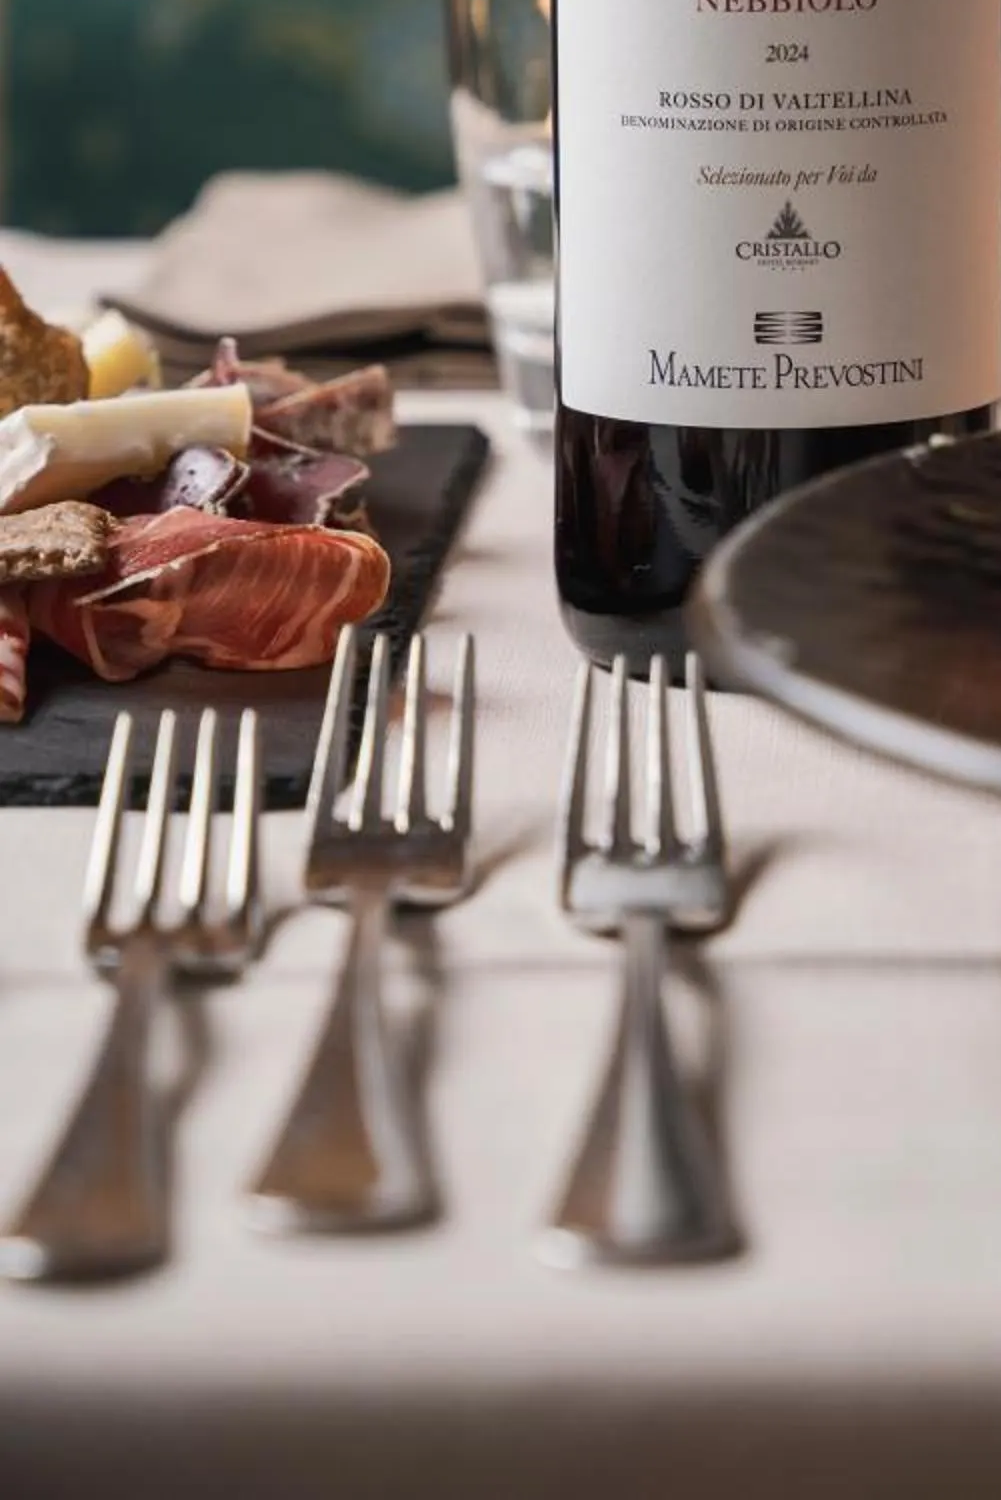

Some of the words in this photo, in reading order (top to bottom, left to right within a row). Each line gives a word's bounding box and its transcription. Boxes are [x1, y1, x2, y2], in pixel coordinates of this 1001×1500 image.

[765, 43, 810, 63] 2024
[659, 91, 732, 111] ROSSO
[738, 92, 766, 112] DI
[773, 88, 913, 111] VALTELLINA
[620, 114, 750, 133] DENOMINAZIONE
[752, 118, 772, 133] DI
[775, 117, 847, 132] ORIGINE
[849, 112, 948, 131] CONTROLLATA
[697, 165, 791, 186] Selezionato
[794, 169, 824, 192] per
[827, 164, 855, 185] Voi
[857, 164, 877, 184] da
[735, 240, 841, 260] CRISTALLO
[649, 349, 768, 389] MAMETE
[774, 352, 924, 390] PREVOSTINI
